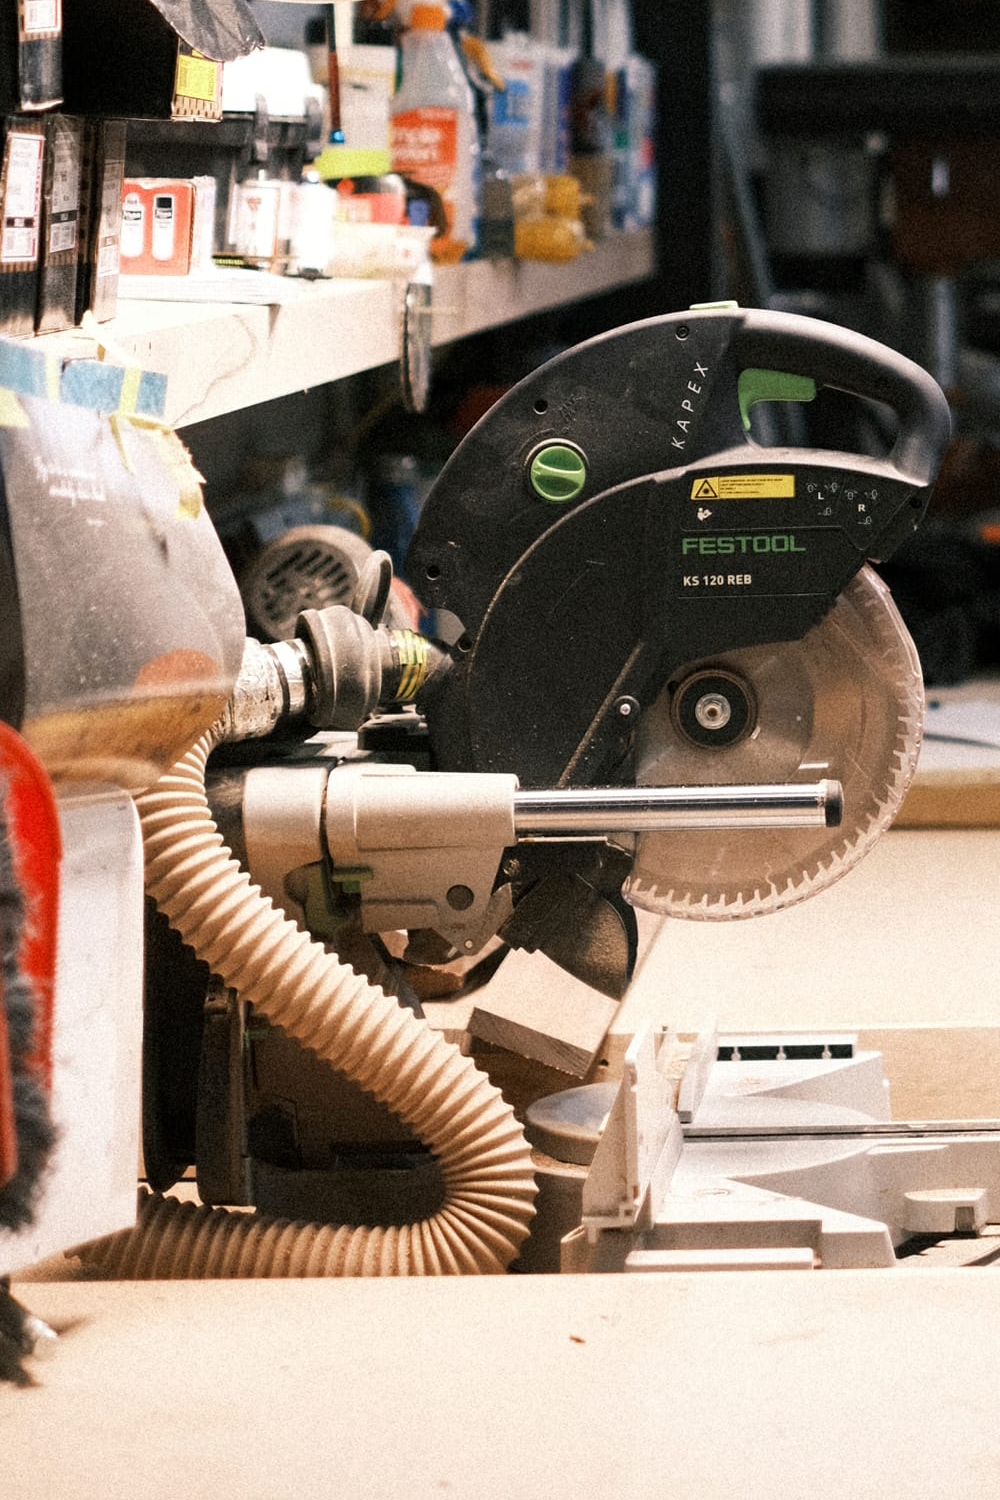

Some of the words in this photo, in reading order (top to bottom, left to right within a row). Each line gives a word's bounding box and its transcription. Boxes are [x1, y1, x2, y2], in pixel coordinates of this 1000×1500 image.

[671, 362, 709, 450] KAPEX
[817, 492, 824, 500] L
[858, 503, 866, 512] R
[682, 535, 806, 555] FESTOOL
[683, 575, 700, 587] KS
[703, 574, 724, 586] 120
[727, 573, 752, 585] REB
